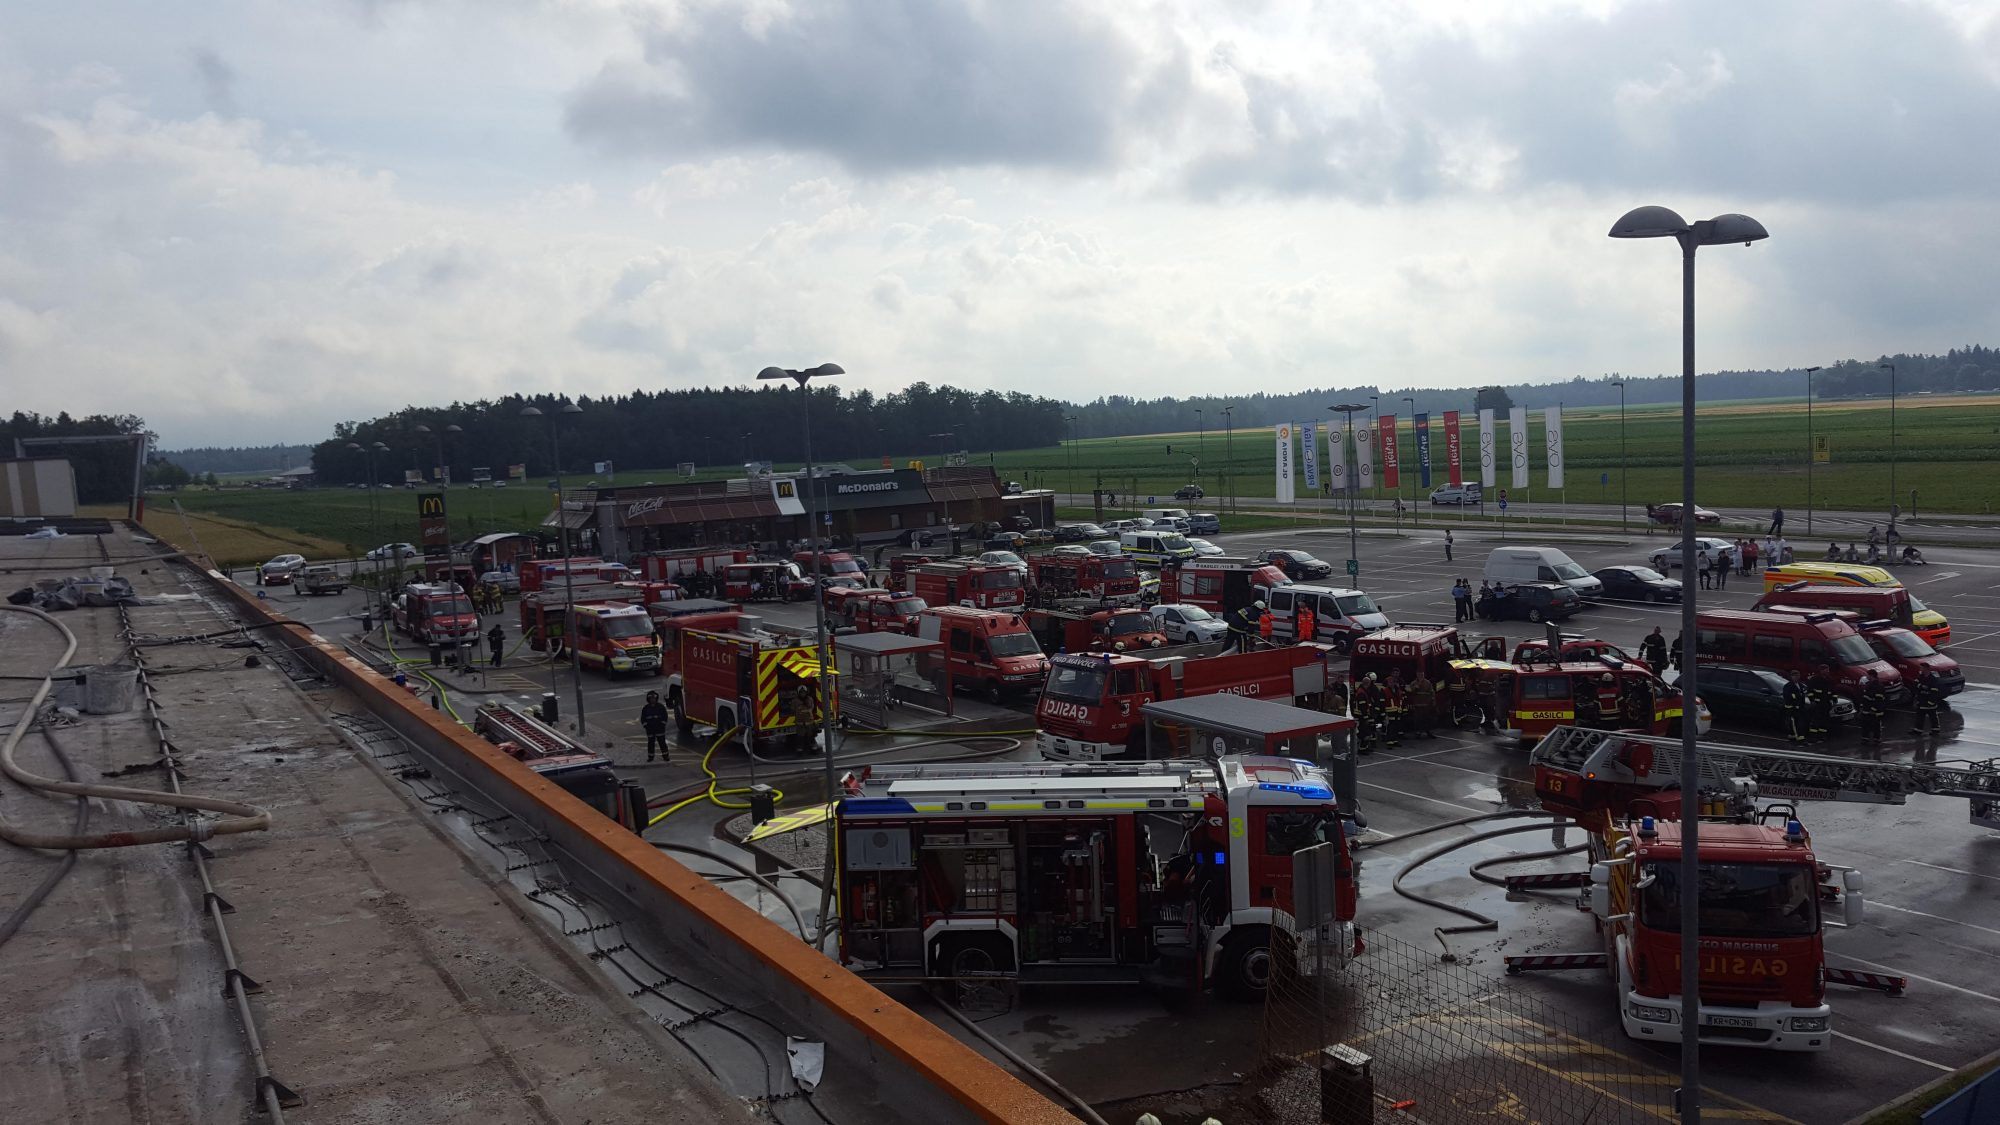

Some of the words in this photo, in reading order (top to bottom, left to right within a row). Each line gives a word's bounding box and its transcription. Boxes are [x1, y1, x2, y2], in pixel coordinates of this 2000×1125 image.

[838, 481, 899, 493] McDonald's
[692, 646, 731, 665] GASILCI
[1357, 643, 1415, 656] GASILCI
[1532, 711, 1564, 719] GASILCI
[1549, 779, 1562, 792] 13
[1231, 817, 1244, 838] 3
[1722, 942, 1780, 952] MAGIRUS
